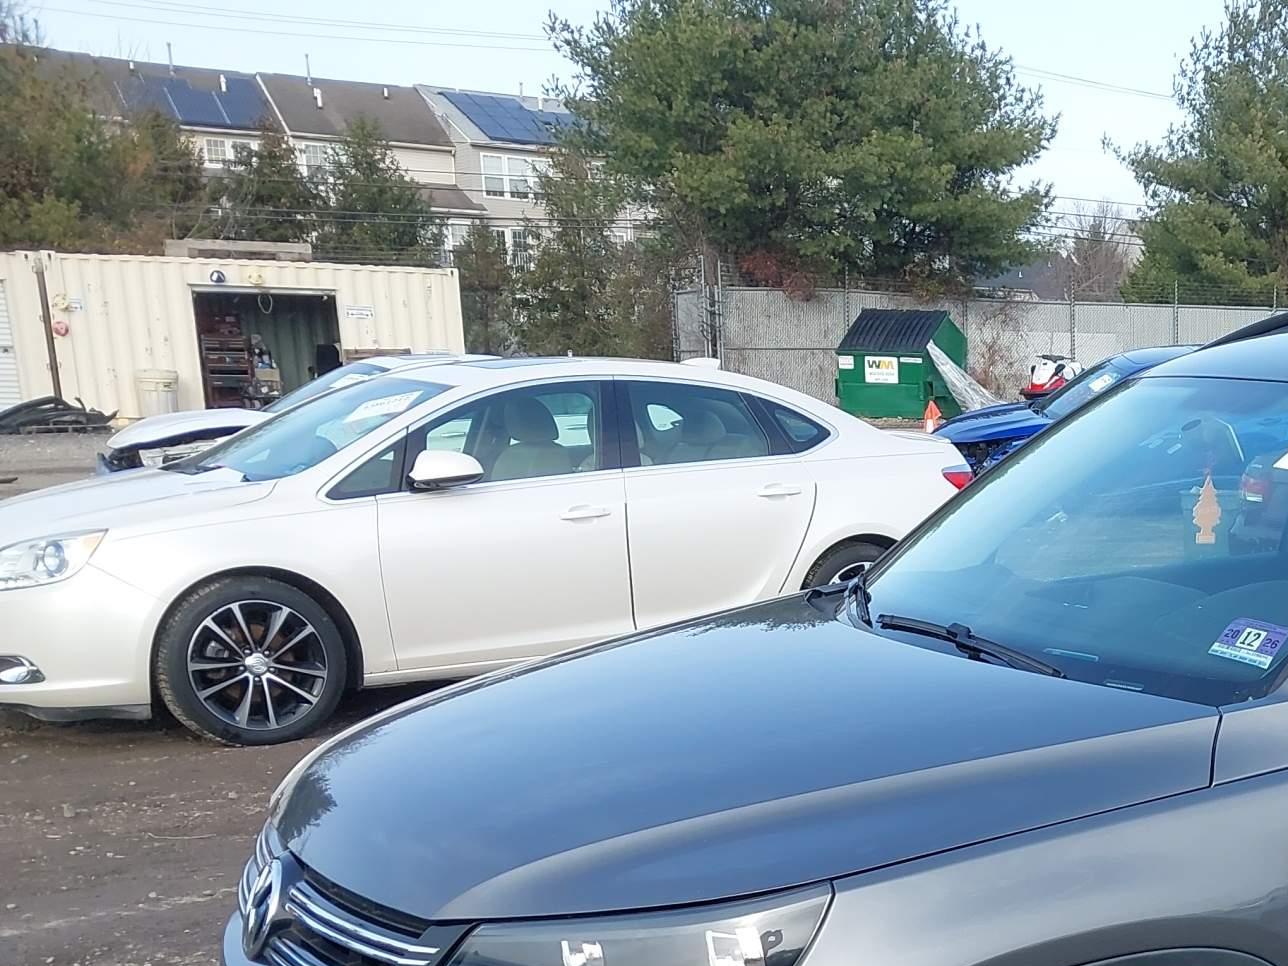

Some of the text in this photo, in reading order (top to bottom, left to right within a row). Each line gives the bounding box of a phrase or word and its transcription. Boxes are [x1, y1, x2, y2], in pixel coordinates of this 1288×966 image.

[867, 359, 894, 370] WM
[1224, 628, 1280, 650] 20 12 26
